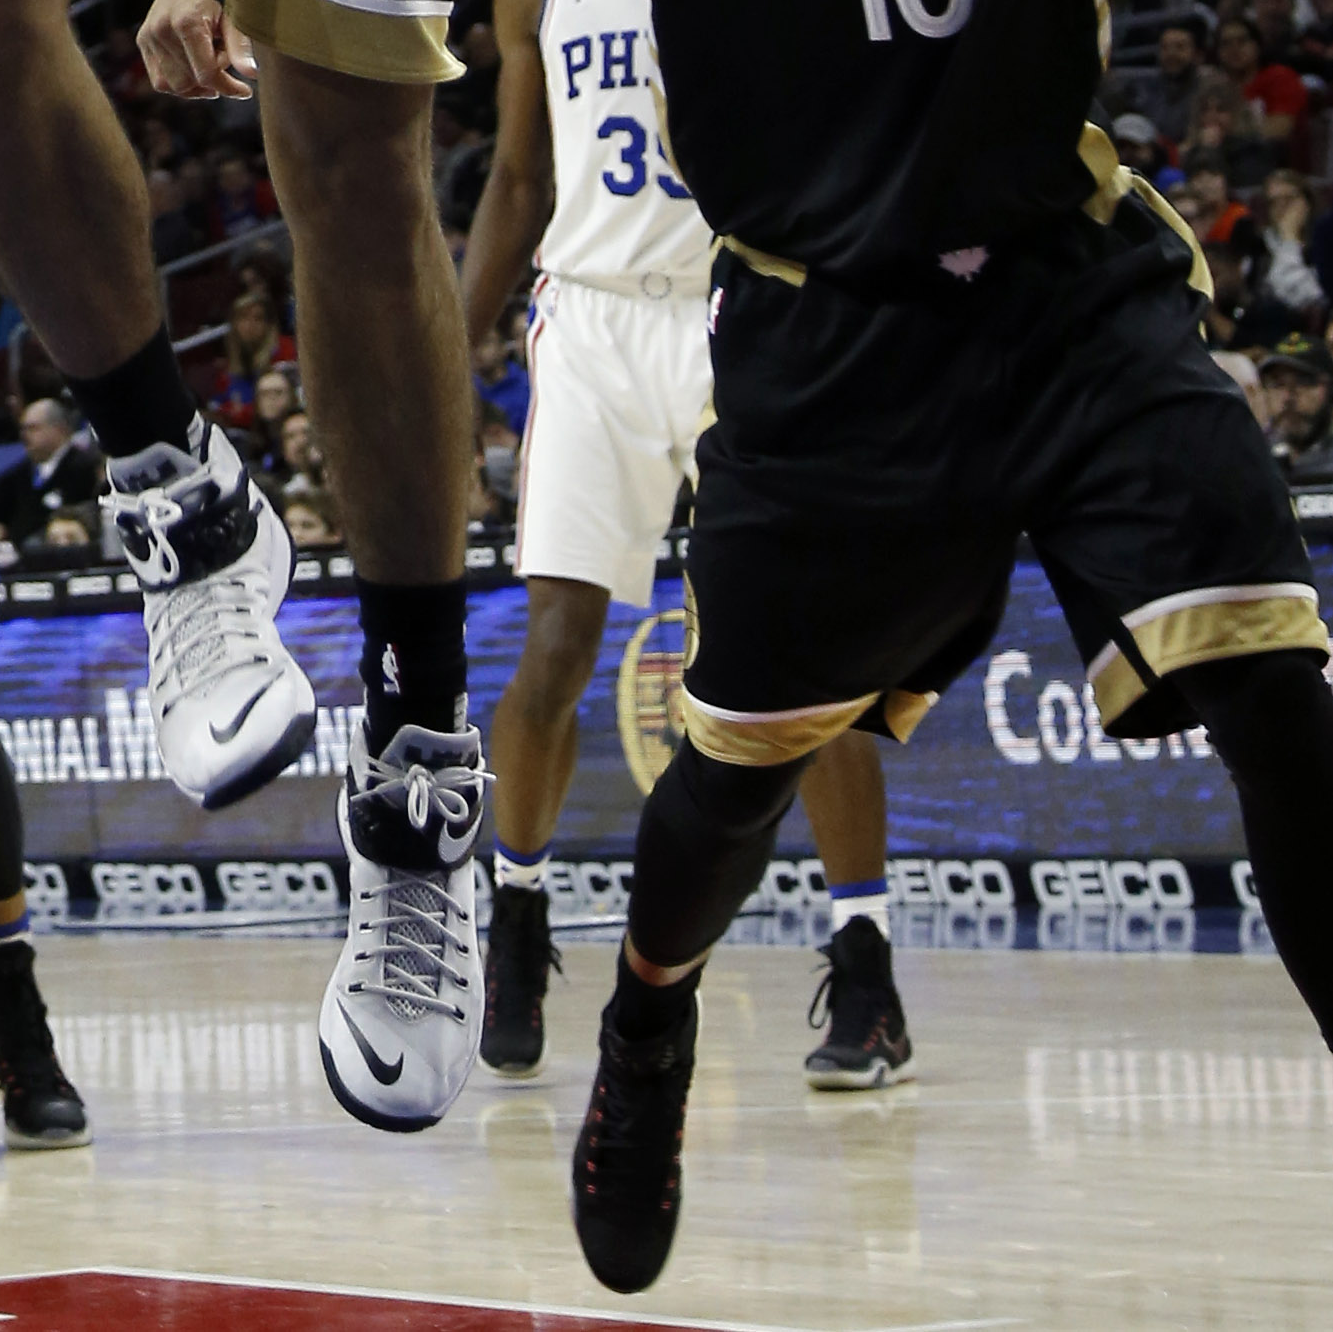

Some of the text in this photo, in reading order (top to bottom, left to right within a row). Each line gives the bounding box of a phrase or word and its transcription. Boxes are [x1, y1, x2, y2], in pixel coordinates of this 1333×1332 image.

[561, 29, 650, 100] PH
[92, 863, 206, 901] GEICO
[216, 862, 340, 901] GEICO
[886, 859, 1015, 905] EICO
[1030, 860, 1195, 908] GEICO
